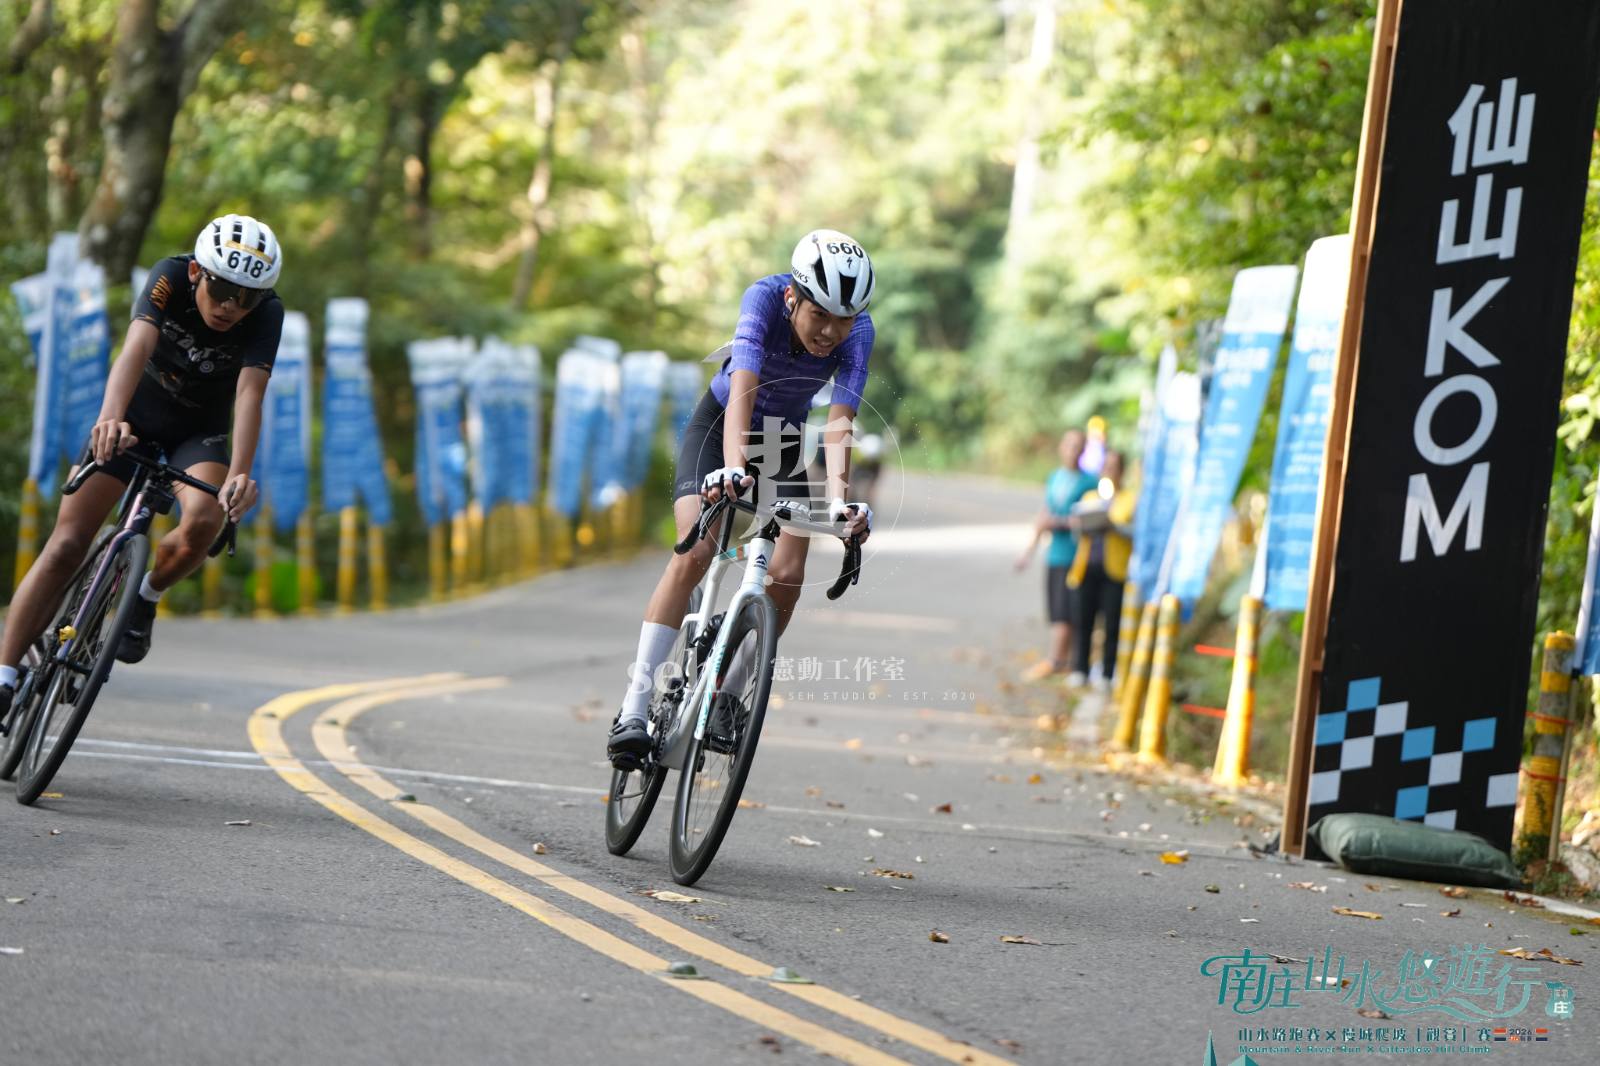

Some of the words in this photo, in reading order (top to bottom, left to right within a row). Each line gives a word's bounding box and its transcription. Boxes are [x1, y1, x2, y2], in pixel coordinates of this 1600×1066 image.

[1436, 77, 1536, 265] 仙山
[227, 250, 264, 279] 618
[826, 242, 864, 258] 660
[1400, 277, 1511, 562] KOM
